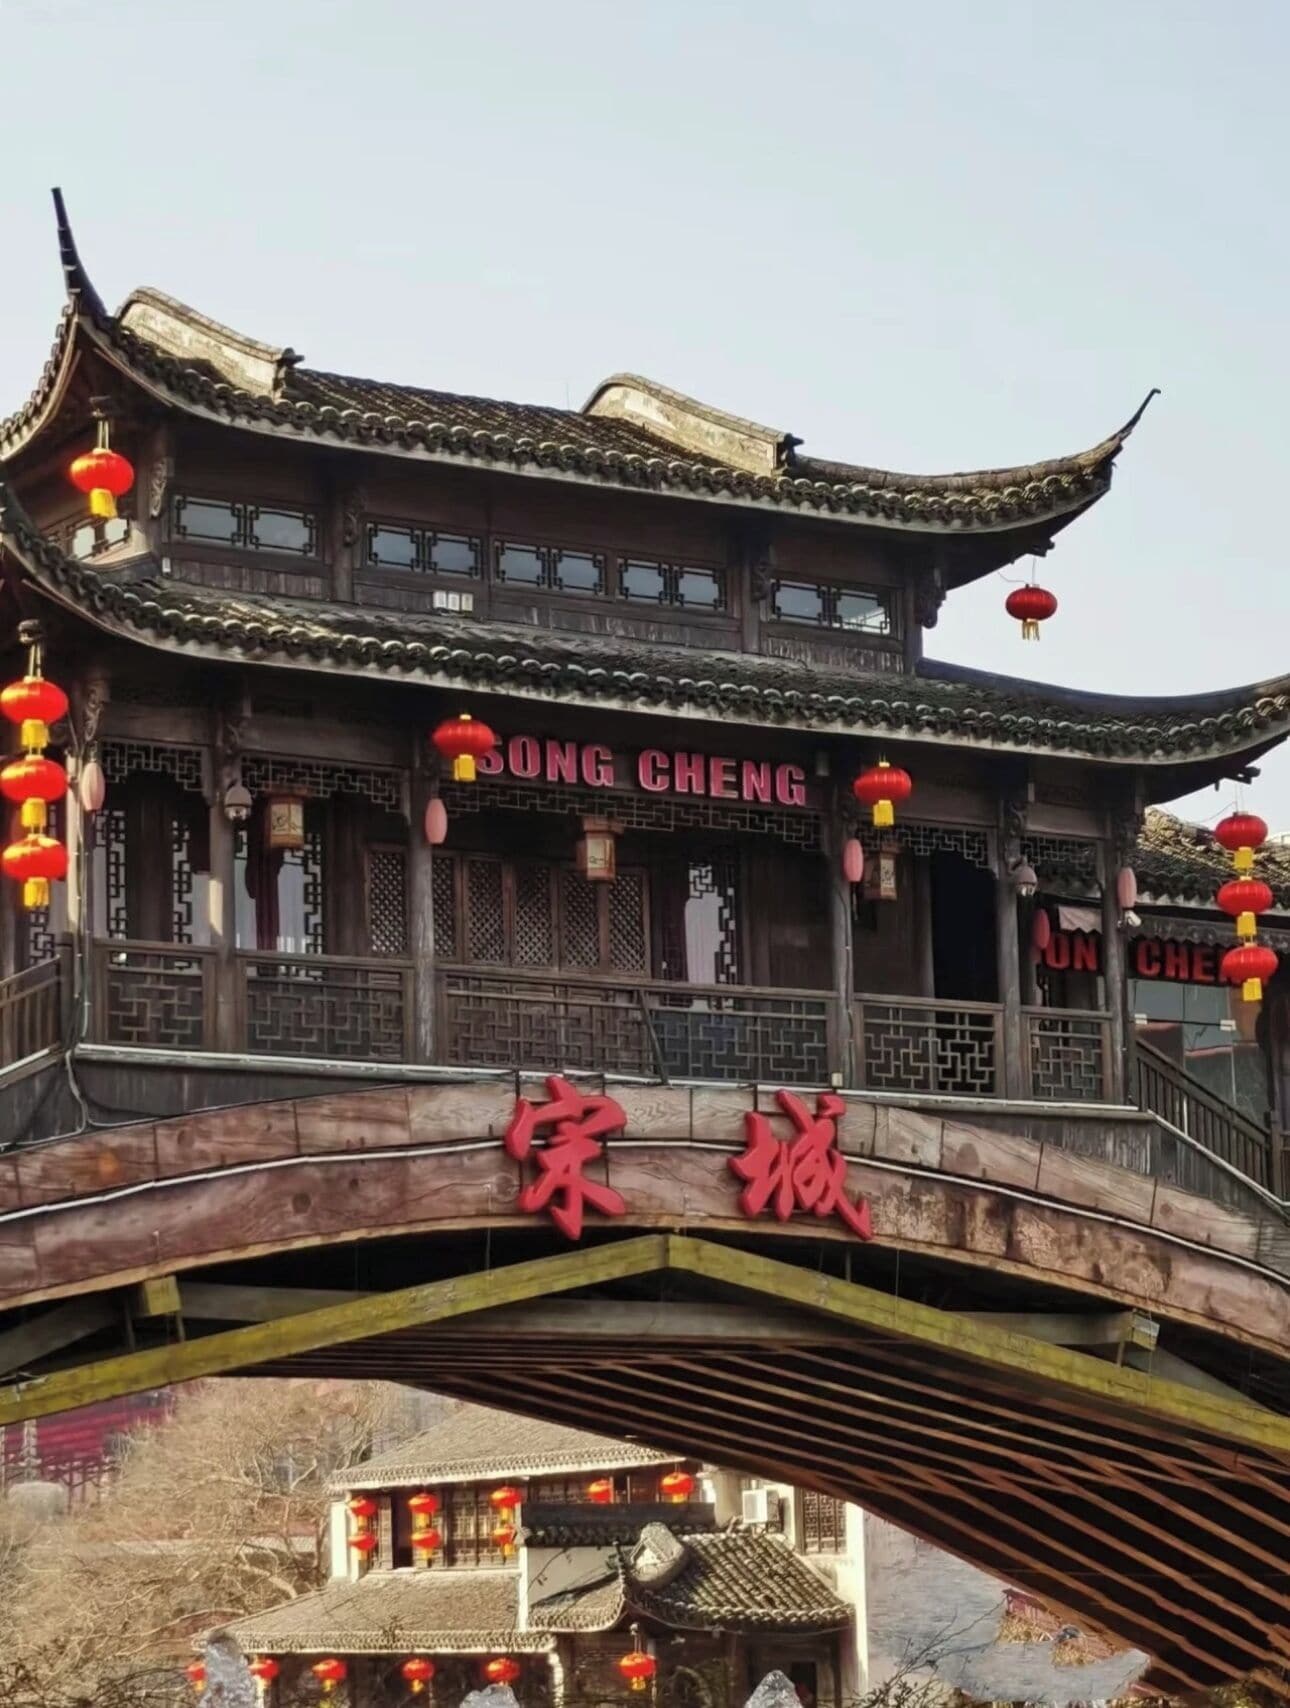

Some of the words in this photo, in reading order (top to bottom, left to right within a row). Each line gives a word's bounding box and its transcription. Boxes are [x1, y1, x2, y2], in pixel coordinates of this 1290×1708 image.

[639, 749, 807, 806] CHENG
[1136, 939, 1244, 983] CHE
[504, 1075, 873, 1241] 宋城
